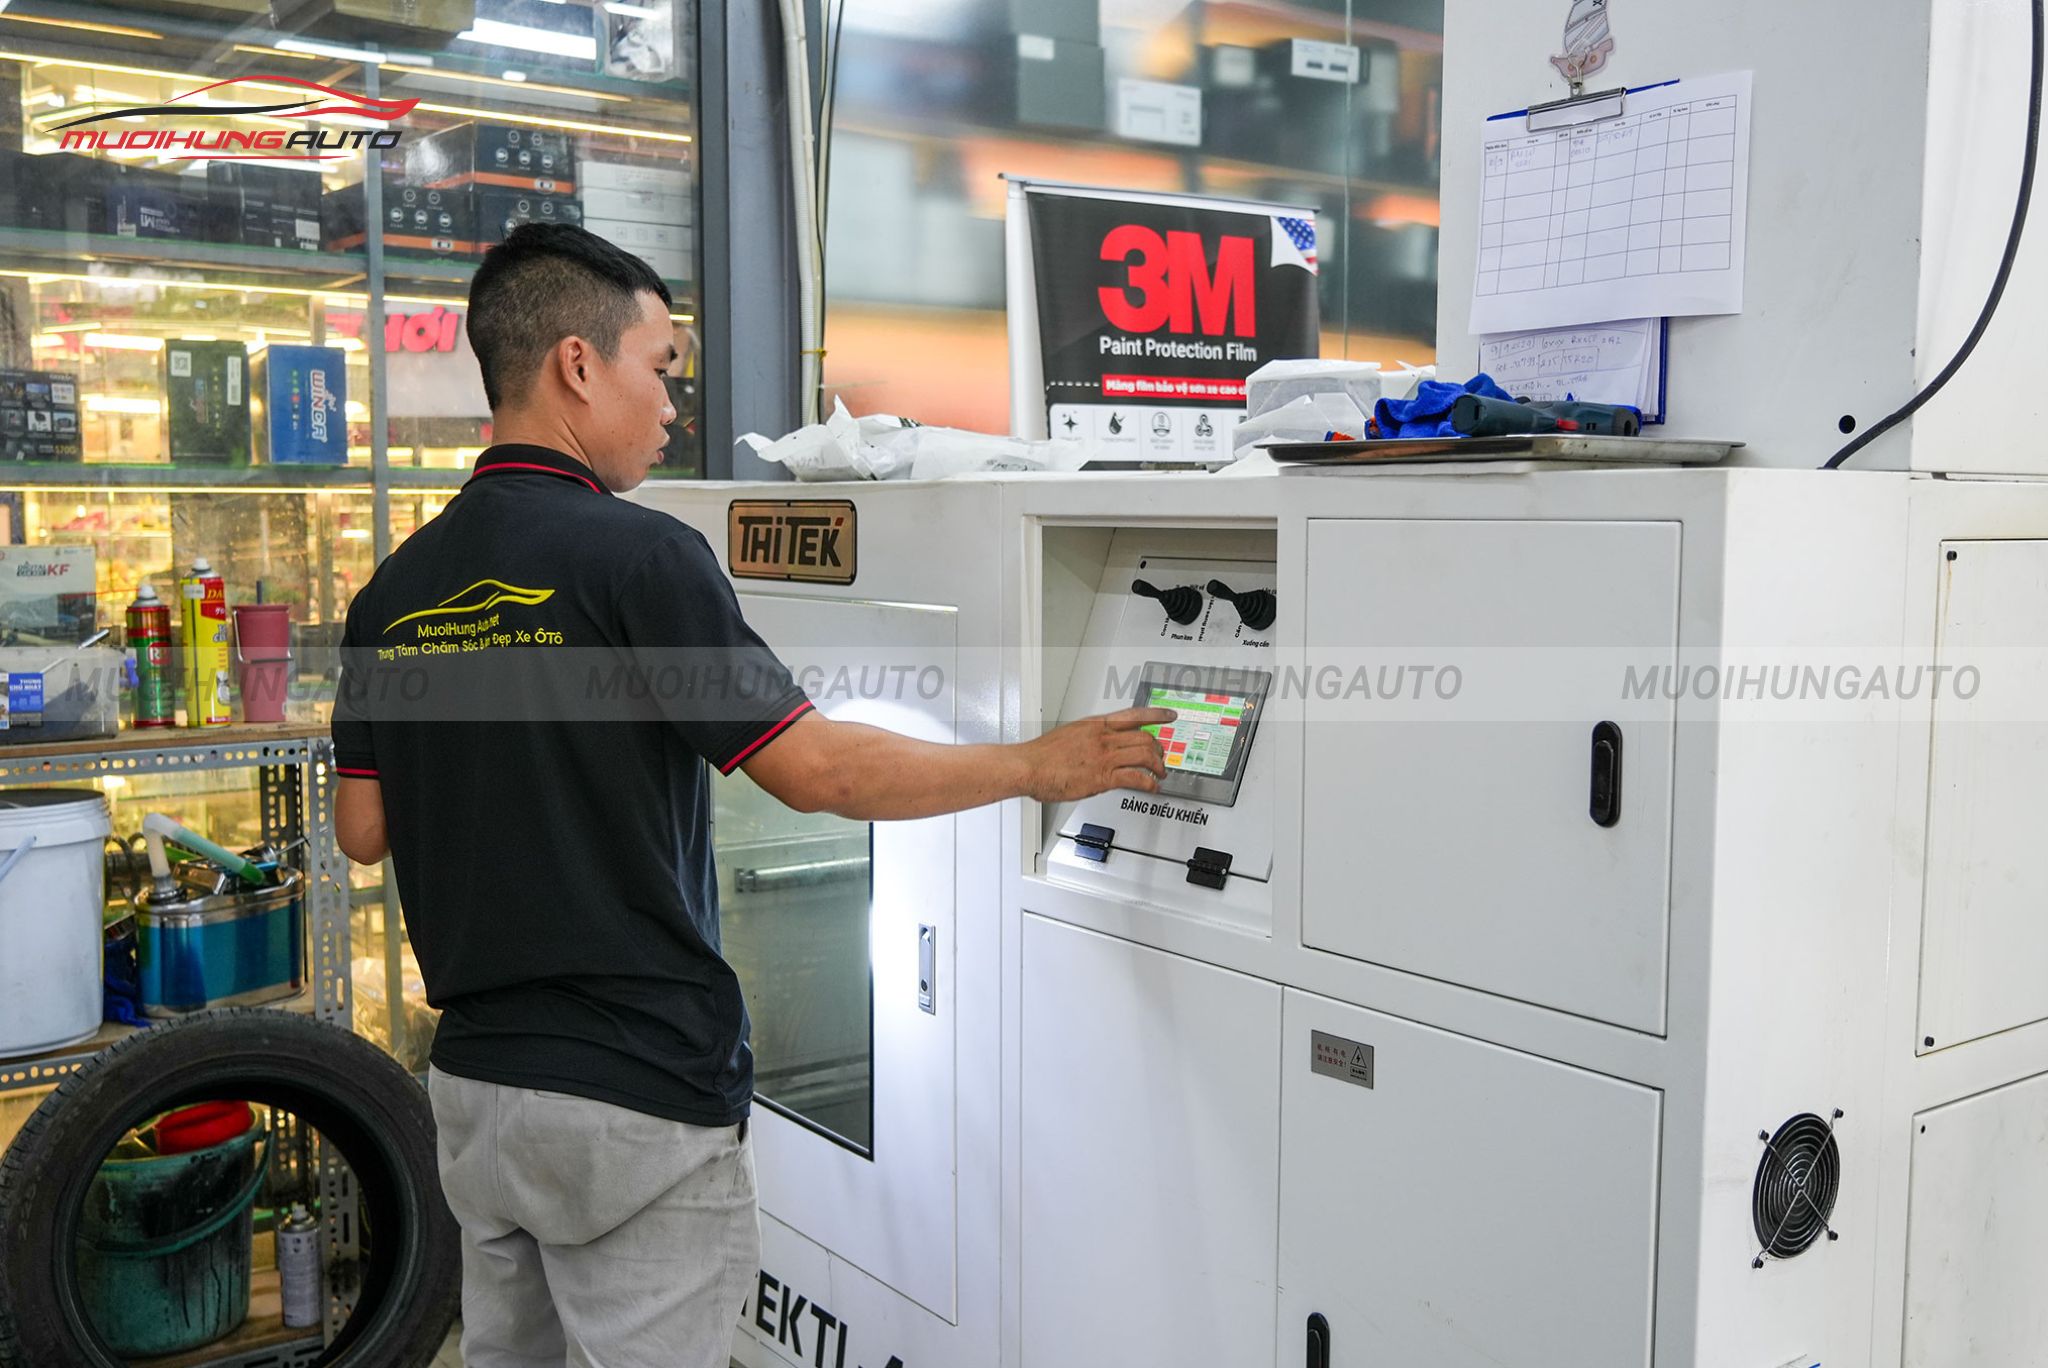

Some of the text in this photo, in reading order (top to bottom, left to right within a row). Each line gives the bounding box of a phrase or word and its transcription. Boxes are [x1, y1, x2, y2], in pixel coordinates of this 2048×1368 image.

[1098, 224, 1256, 338] 3M
[1099, 336, 1257, 362] Paint Protection Film
[417, 622, 476, 639] MuoiHung
[421, 641, 460, 655] Chăm
[462, 639, 479, 652] Sóc
[492, 632, 512, 648] Đẹp
[515, 629, 531, 643] Xe
[534, 627, 564, 645] ÔTô
[1120, 796, 1149, 814] BẢNG
